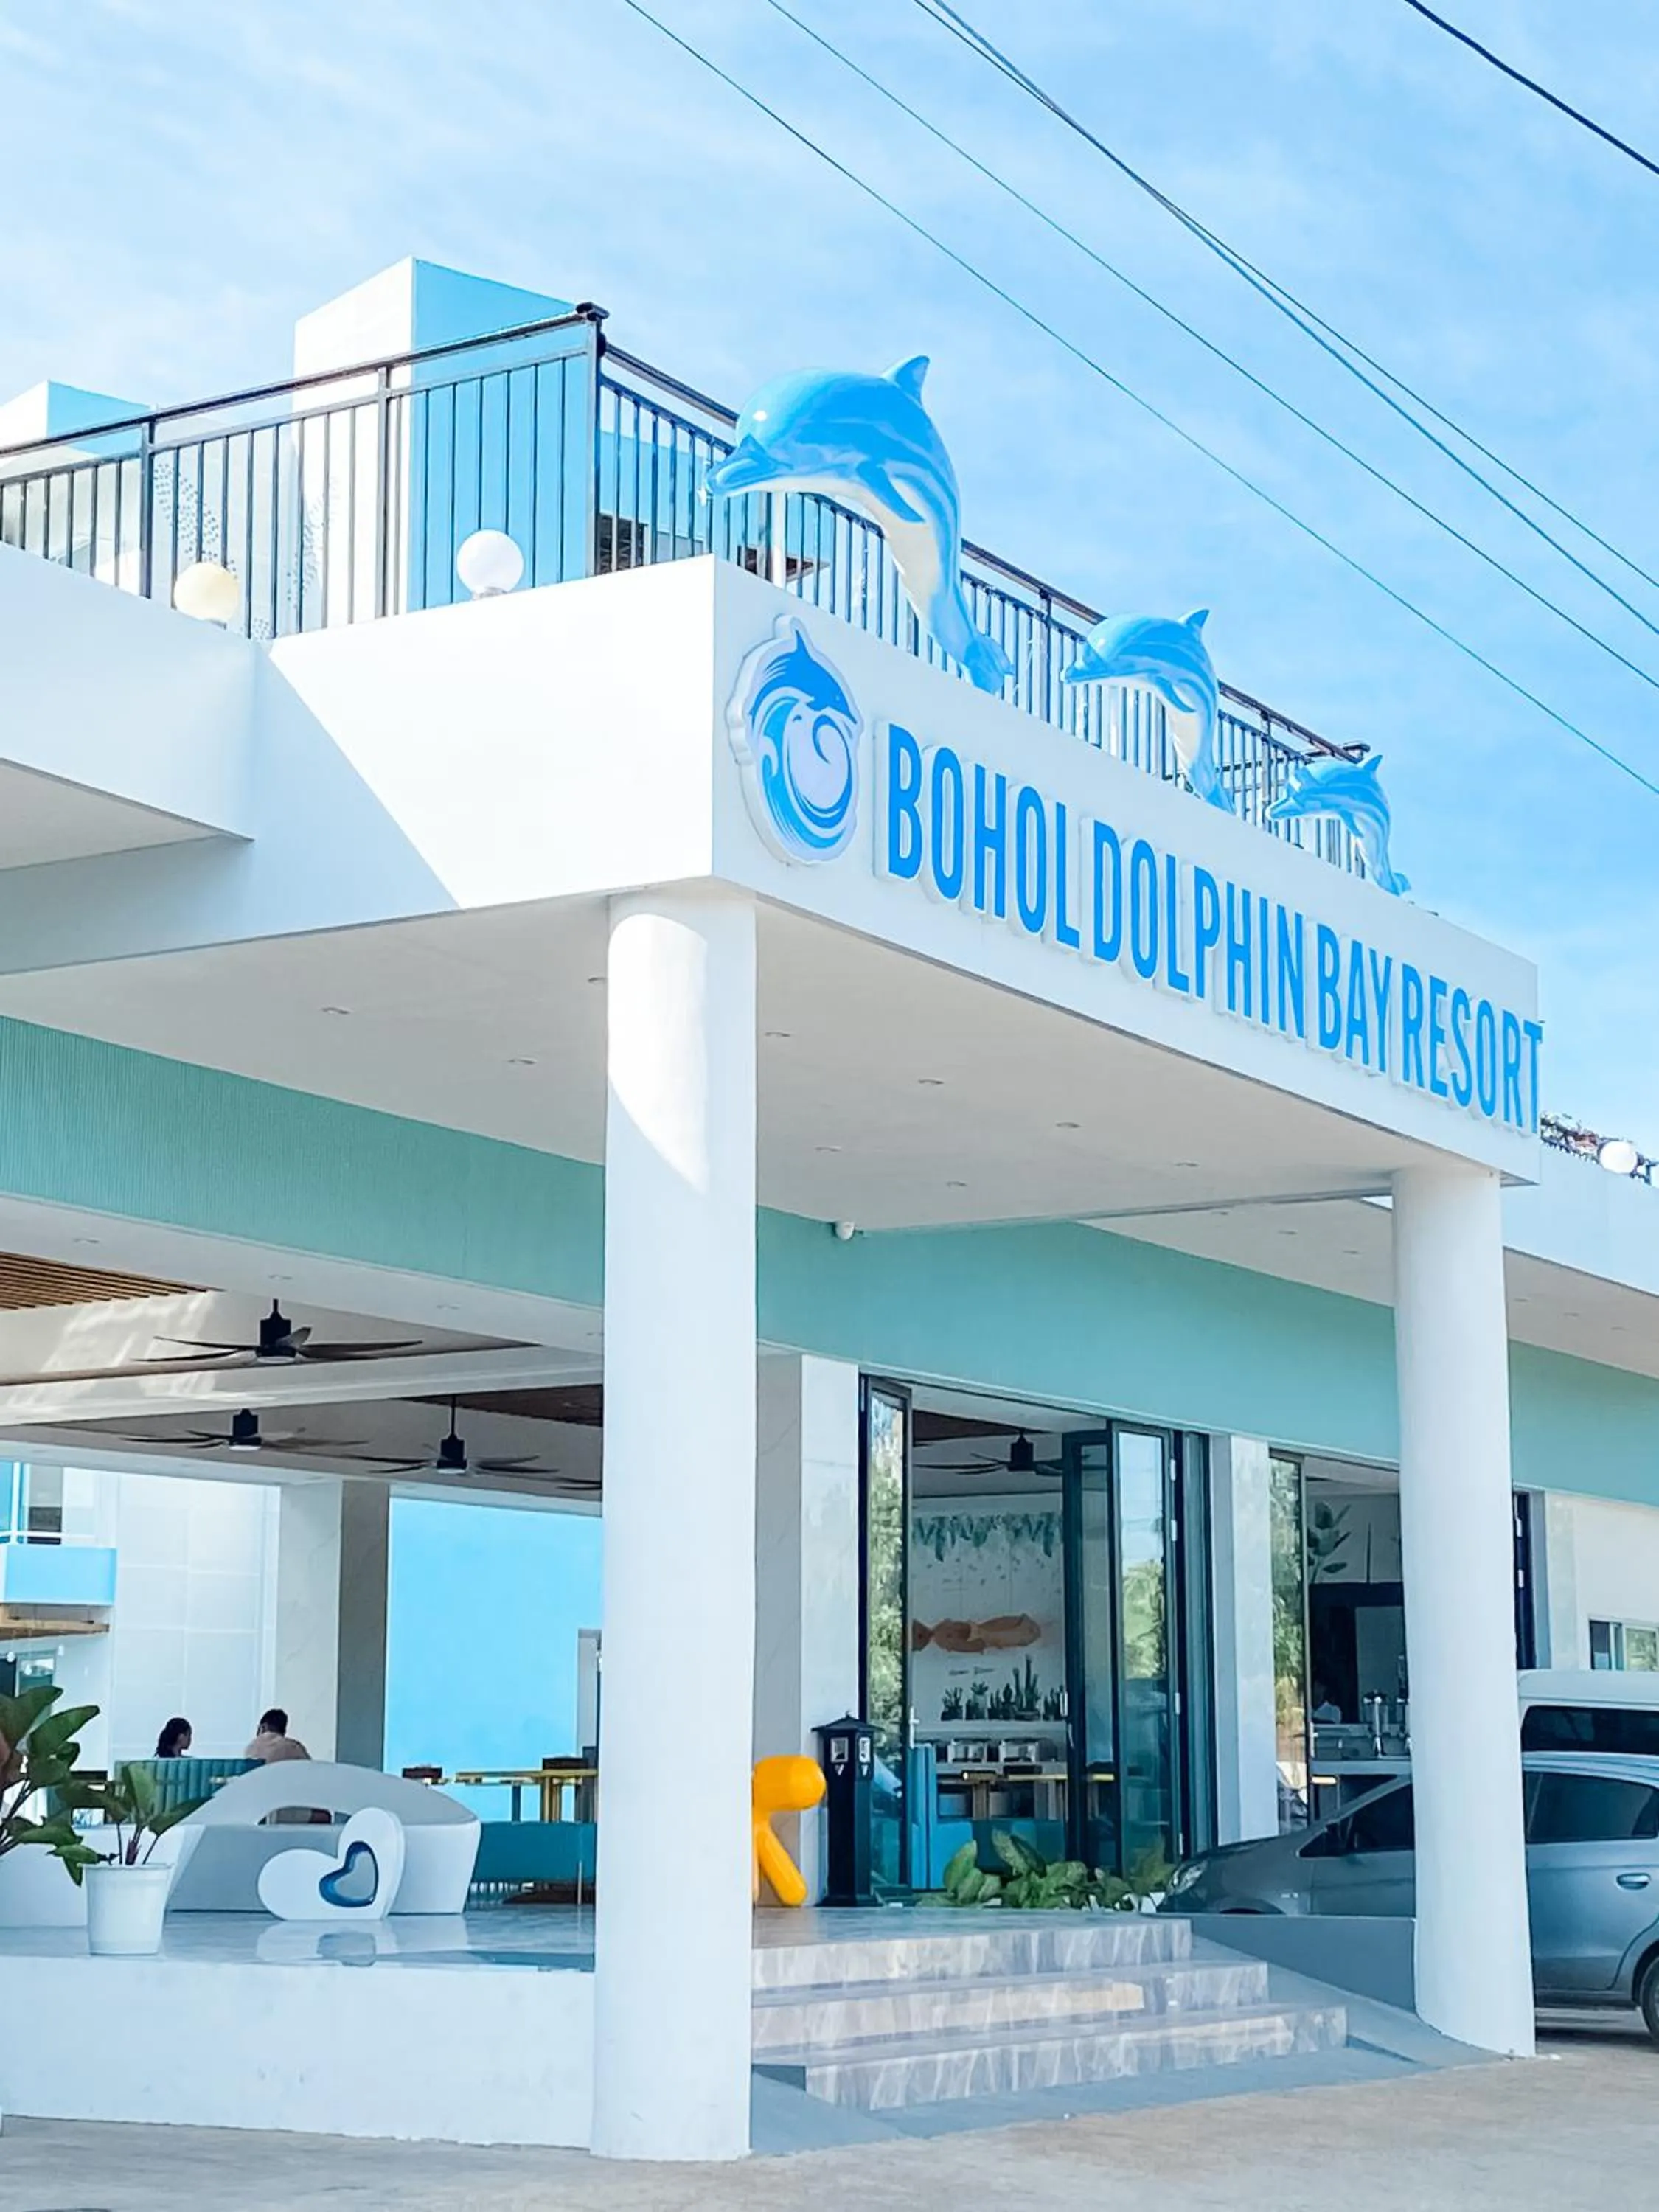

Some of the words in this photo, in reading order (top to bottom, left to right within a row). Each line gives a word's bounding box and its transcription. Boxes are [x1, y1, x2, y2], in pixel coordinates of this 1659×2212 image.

[887, 722, 1080, 950] BOHOL
[1093, 819, 1305, 1040] DOLPHIN
[1316, 923, 1394, 1073] BAY
[1401, 963, 1543, 1133] RESORT
